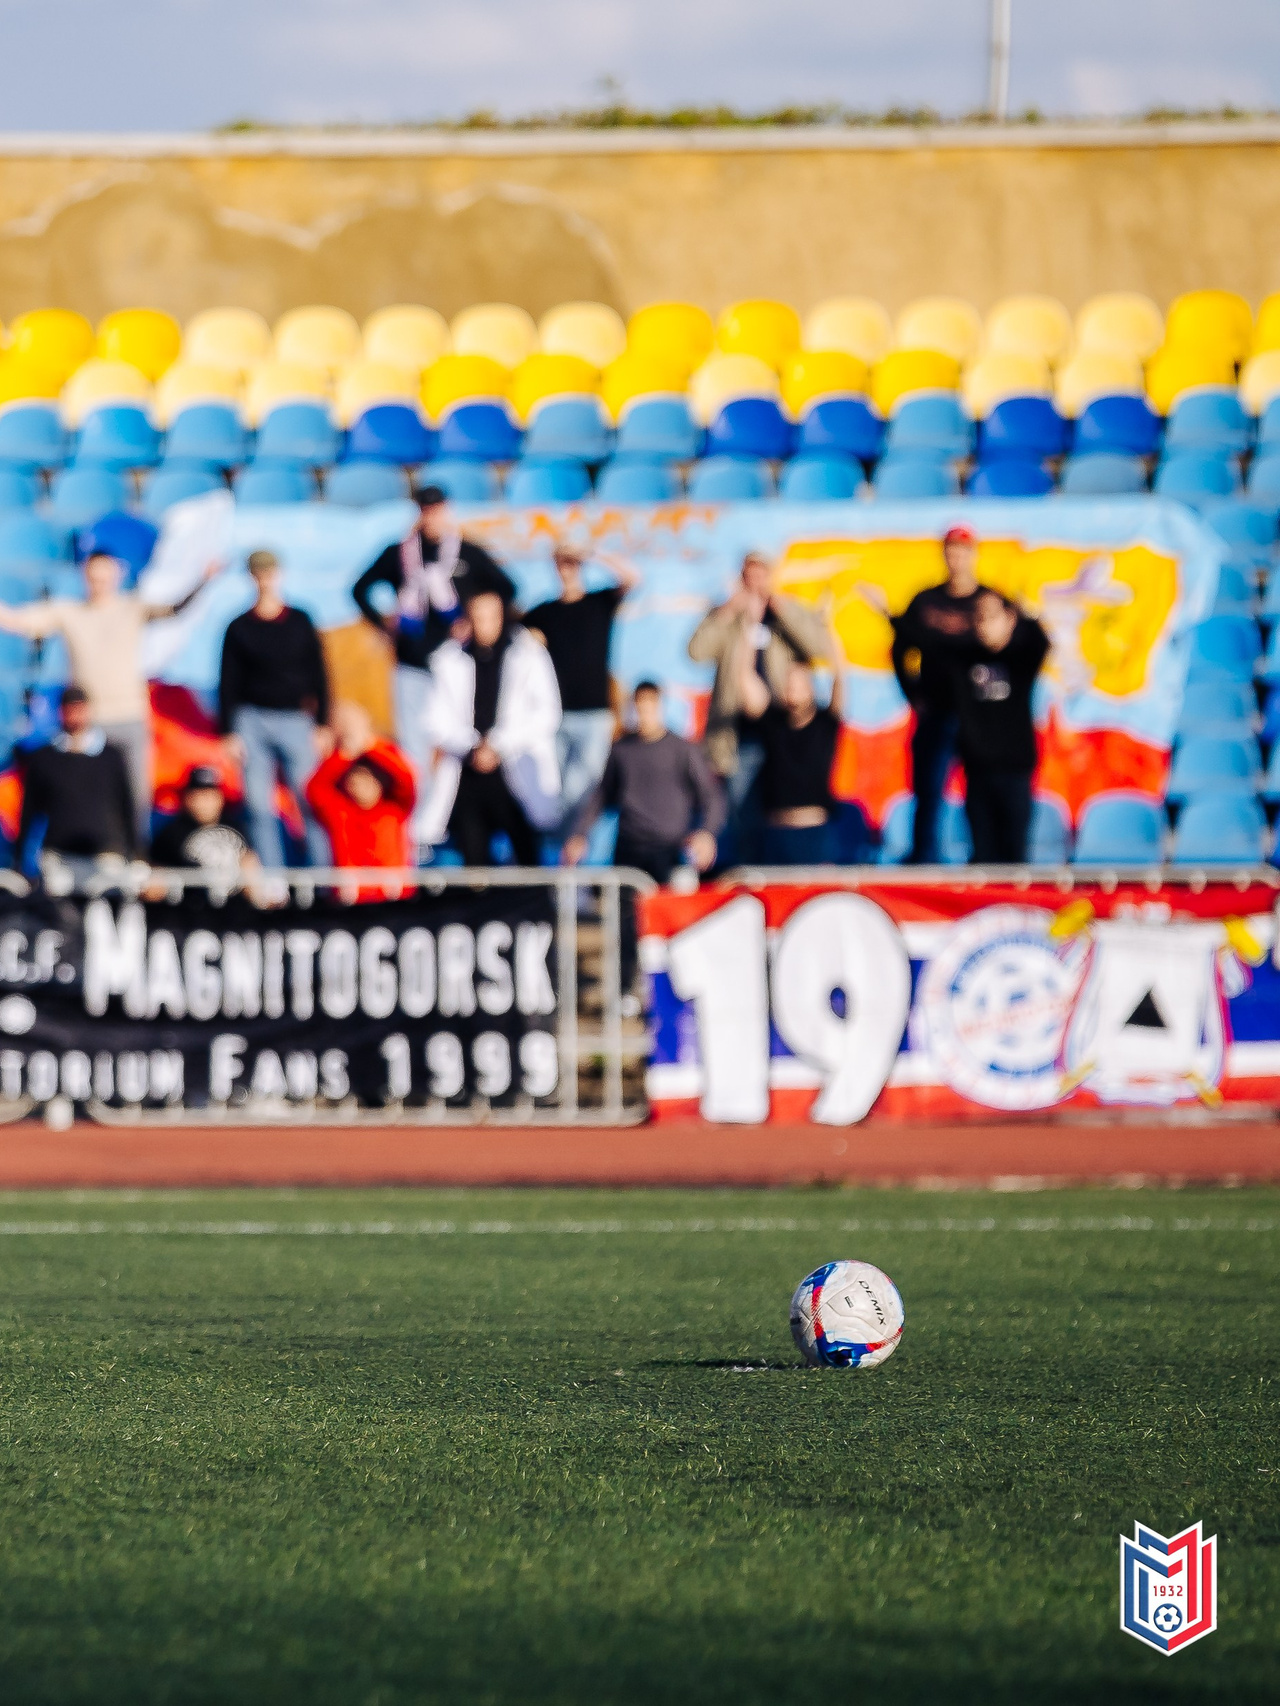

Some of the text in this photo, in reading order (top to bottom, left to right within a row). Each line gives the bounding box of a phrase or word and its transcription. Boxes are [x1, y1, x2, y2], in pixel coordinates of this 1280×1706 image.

[83, 898, 557, 1020] MAGNITOGORSK
[668, 892, 912, 1126] 19
[209, 1032, 352, 1101] FANS
[380, 1030, 559, 1098] 1999
[858, 1280, 887, 1326] DEMIX
